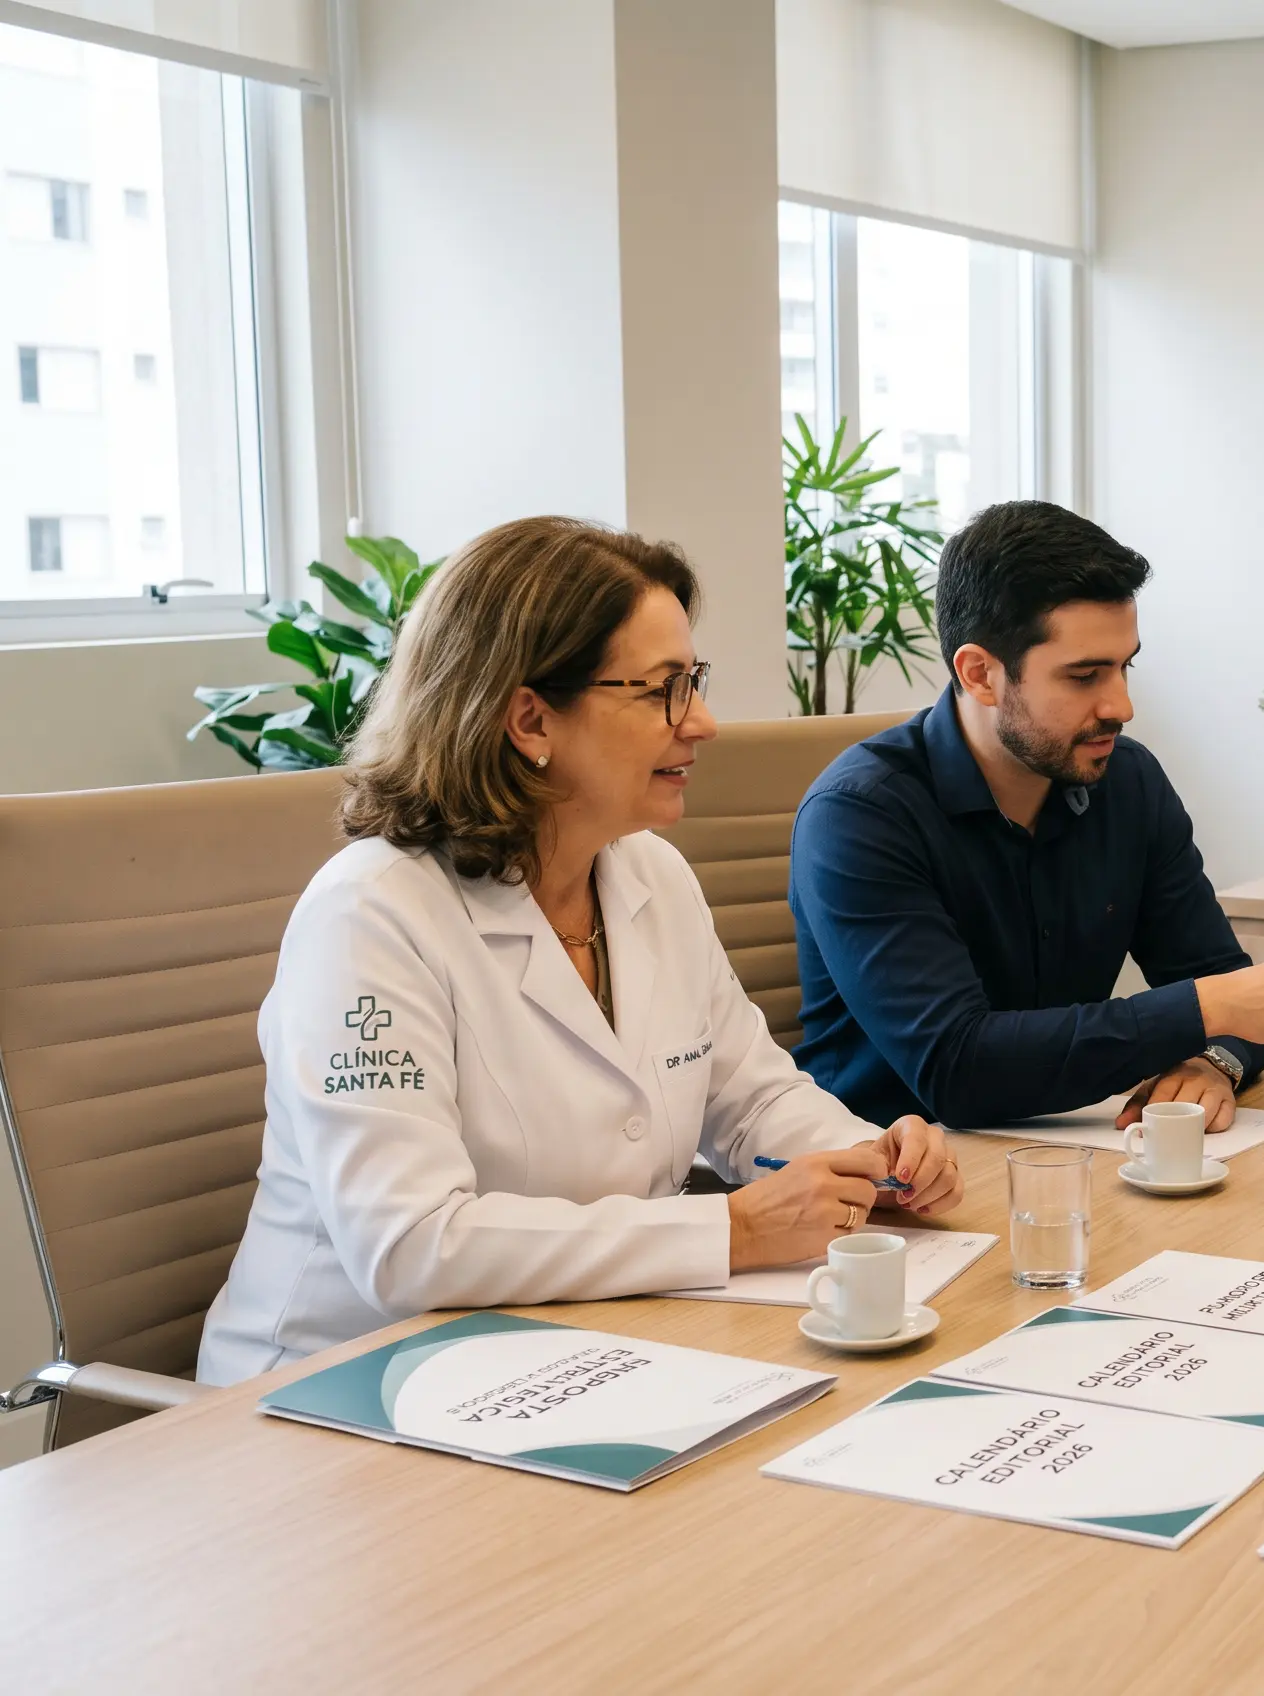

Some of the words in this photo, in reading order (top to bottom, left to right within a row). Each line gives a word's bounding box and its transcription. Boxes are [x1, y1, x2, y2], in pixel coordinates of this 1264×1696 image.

[329, 1046, 417, 1070] CLÍNICA
[666, 1056, 681, 1069] DR
[324, 1071, 395, 1094] SANTA
[400, 1068, 425, 1090] FÉ
[1077, 1331, 1174, 1389] CALENDÁRIO
[1113, 1343, 1195, 1389] EDITORIAL
[1164, 1357, 1208, 1382] 2026
[935, 1408, 1061, 1486] CALENDÁRIO
[980, 1422, 1086, 1485] EDITORIAL
[1041, 1443, 1093, 1475] 2026
